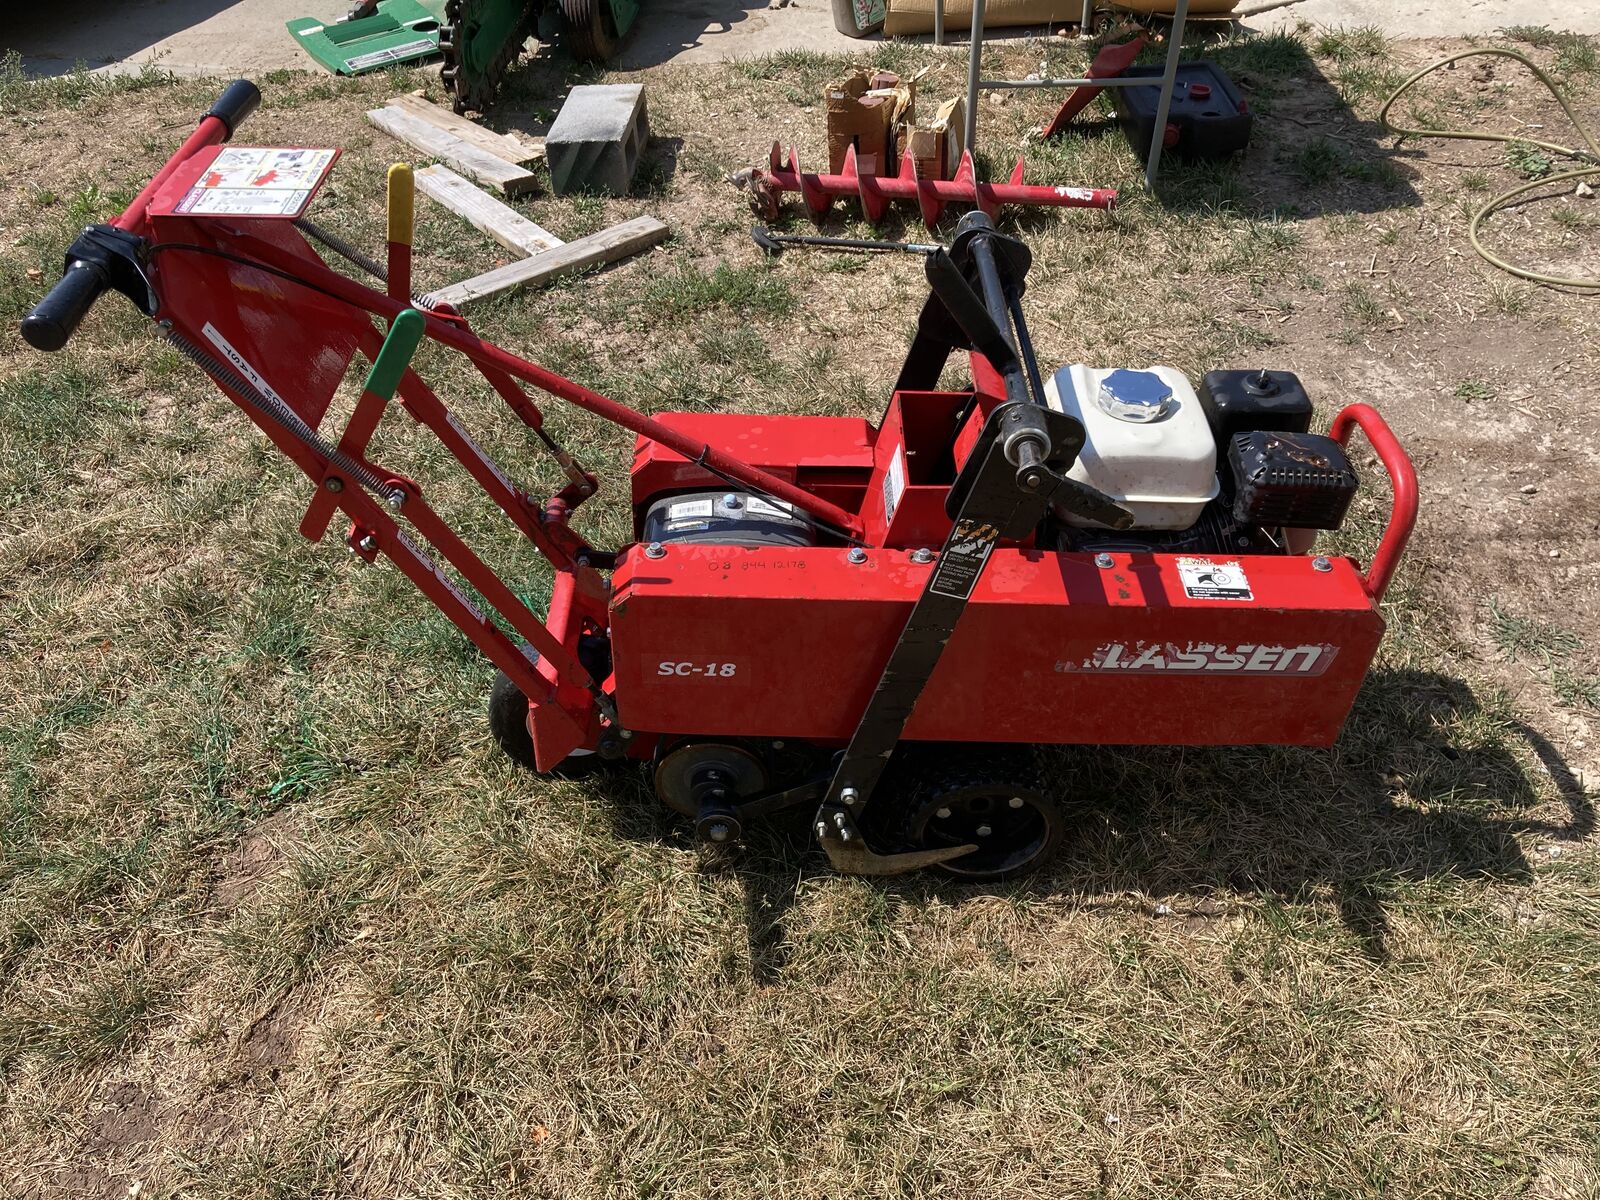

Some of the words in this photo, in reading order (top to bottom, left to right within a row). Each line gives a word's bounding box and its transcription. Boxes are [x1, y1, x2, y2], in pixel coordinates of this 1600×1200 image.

[222, 344, 258, 383] FAST
[400, 532, 436, 571] BLADE
[442, 575, 484, 619] CUTTER
[657, 661, 737, 677] SC-18
[1103, 644, 1323, 672] LASSEN
